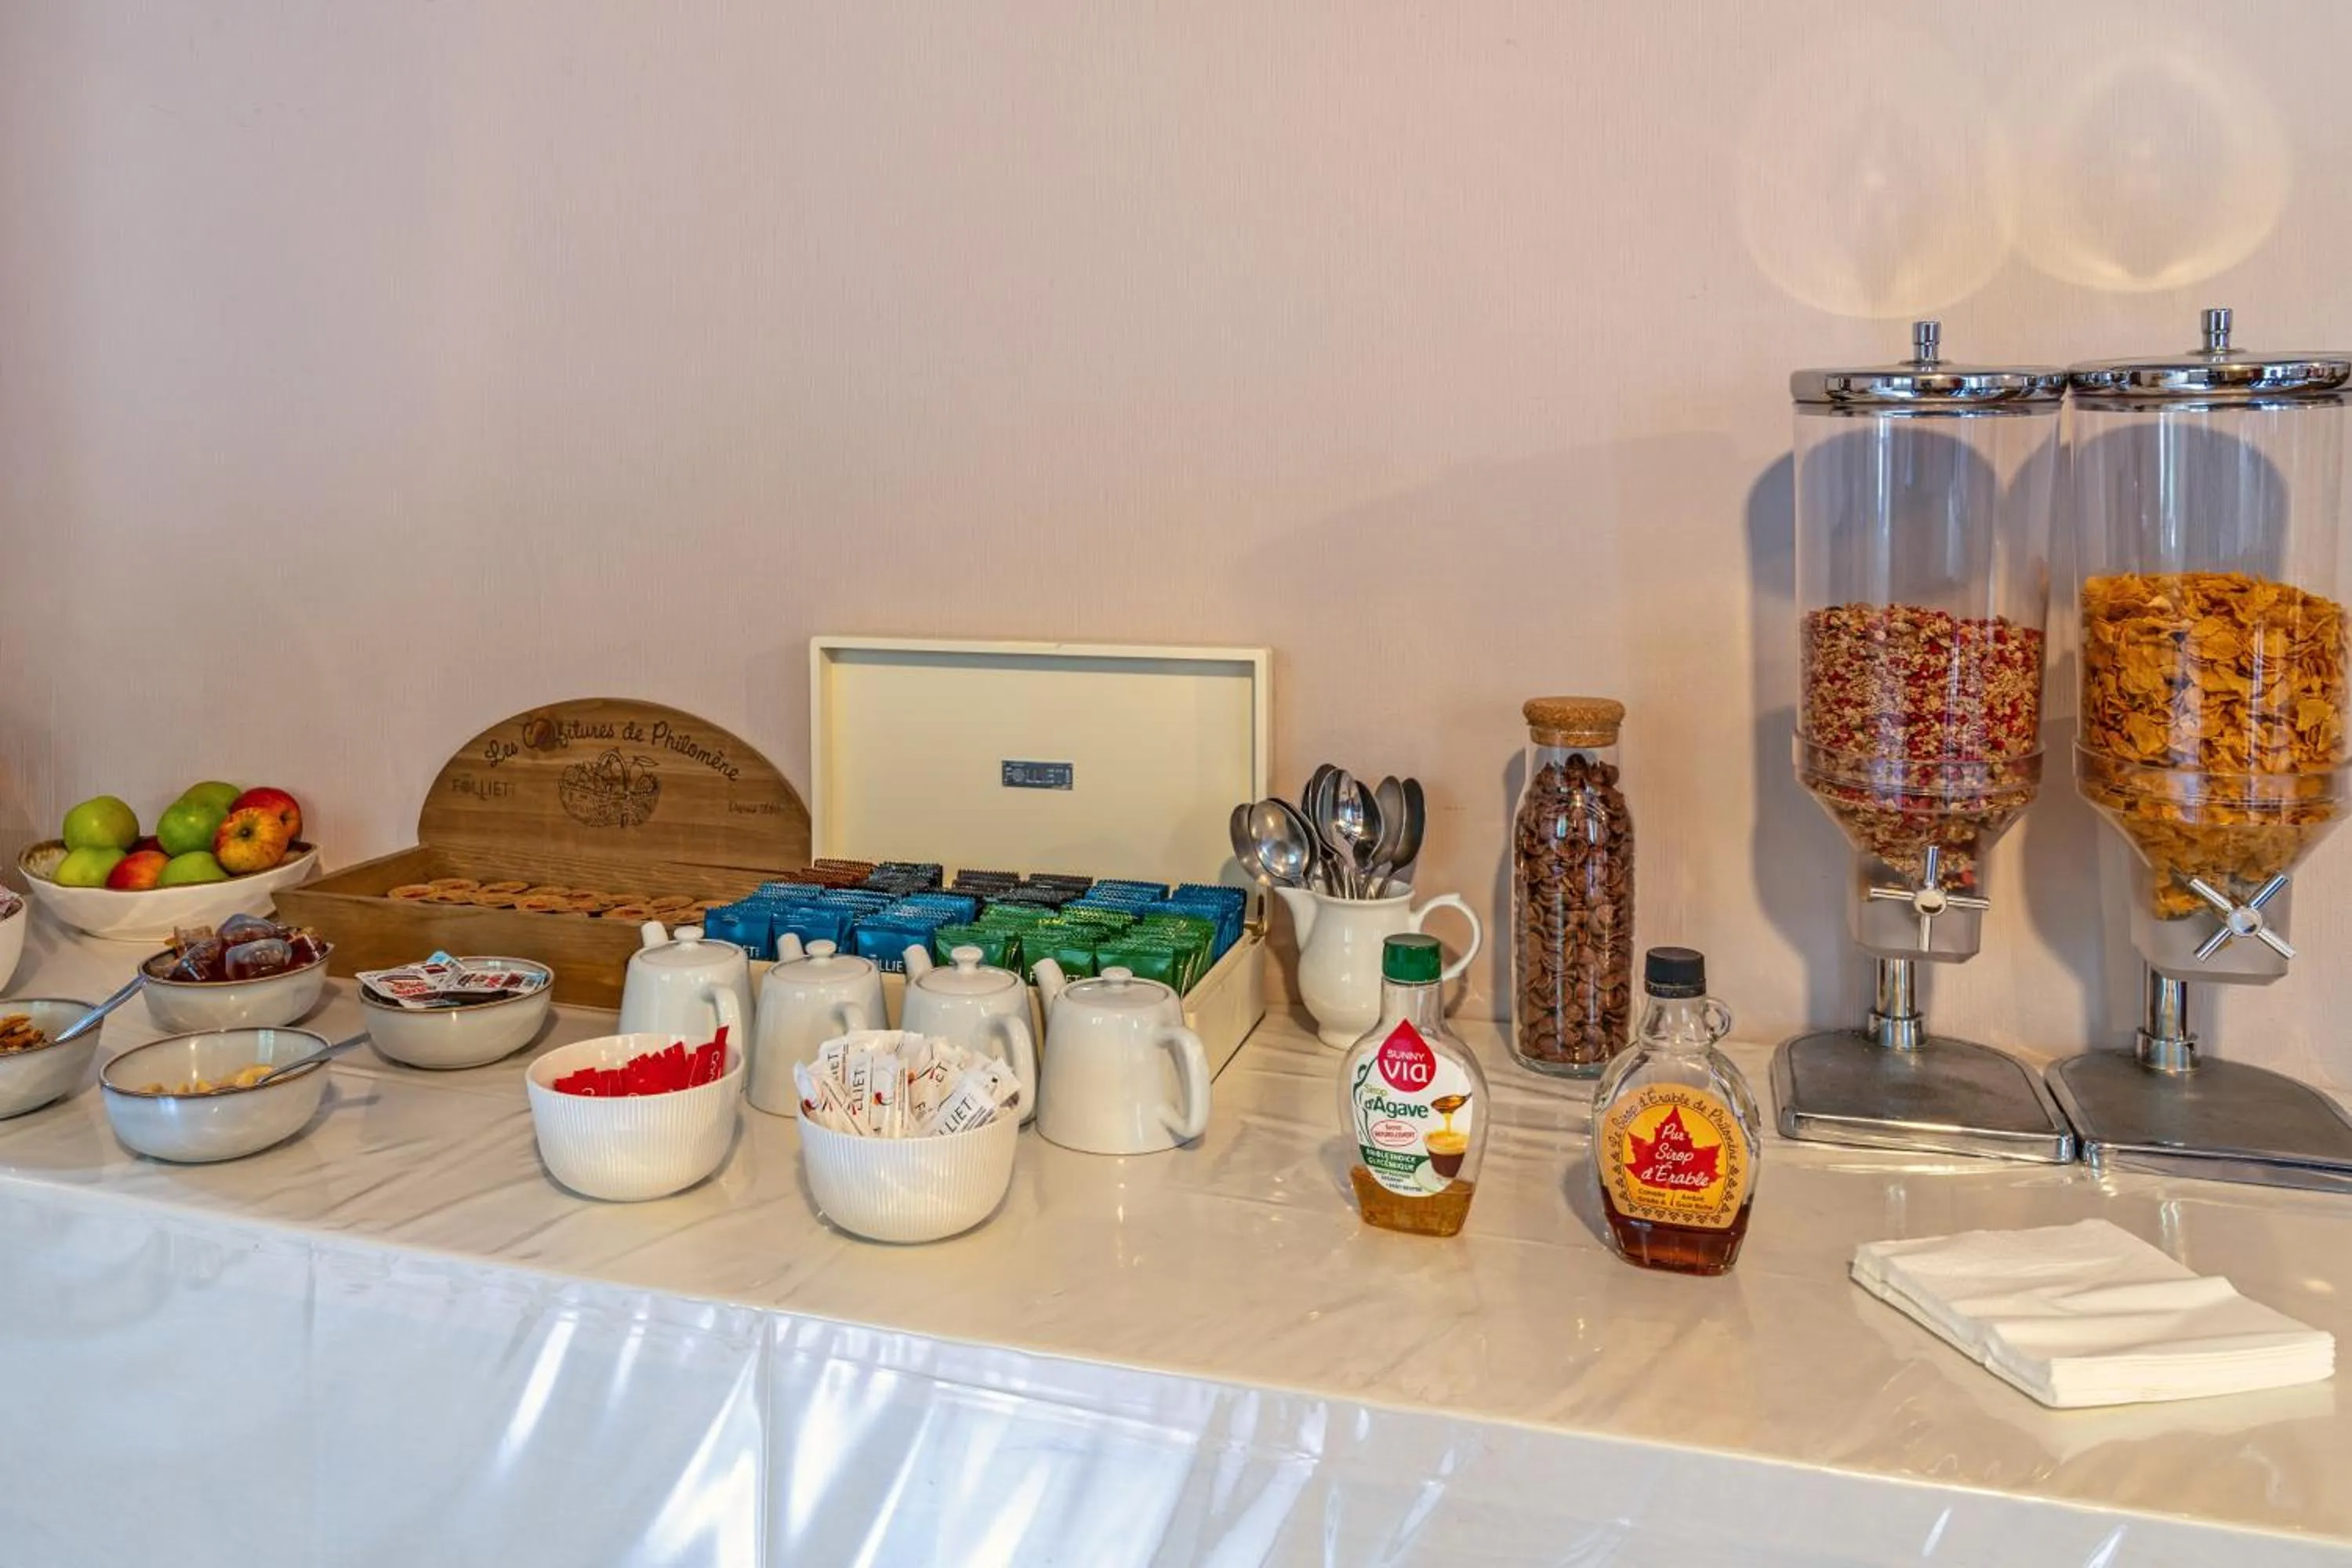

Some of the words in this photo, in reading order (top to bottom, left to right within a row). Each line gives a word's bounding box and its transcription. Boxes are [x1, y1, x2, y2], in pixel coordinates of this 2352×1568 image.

[485, 739, 519, 768] Les
[522, 720, 615, 749] Cfitures
[622, 721, 644, 742] de
[879, 958, 904, 972] LLIE
[852, 1069, 866, 1111] LIET
[1365, 1096, 1429, 1119] d'Agave
[1661, 1123, 1685, 1142] Pur
[1655, 1142, 1694, 1166] Sirop
